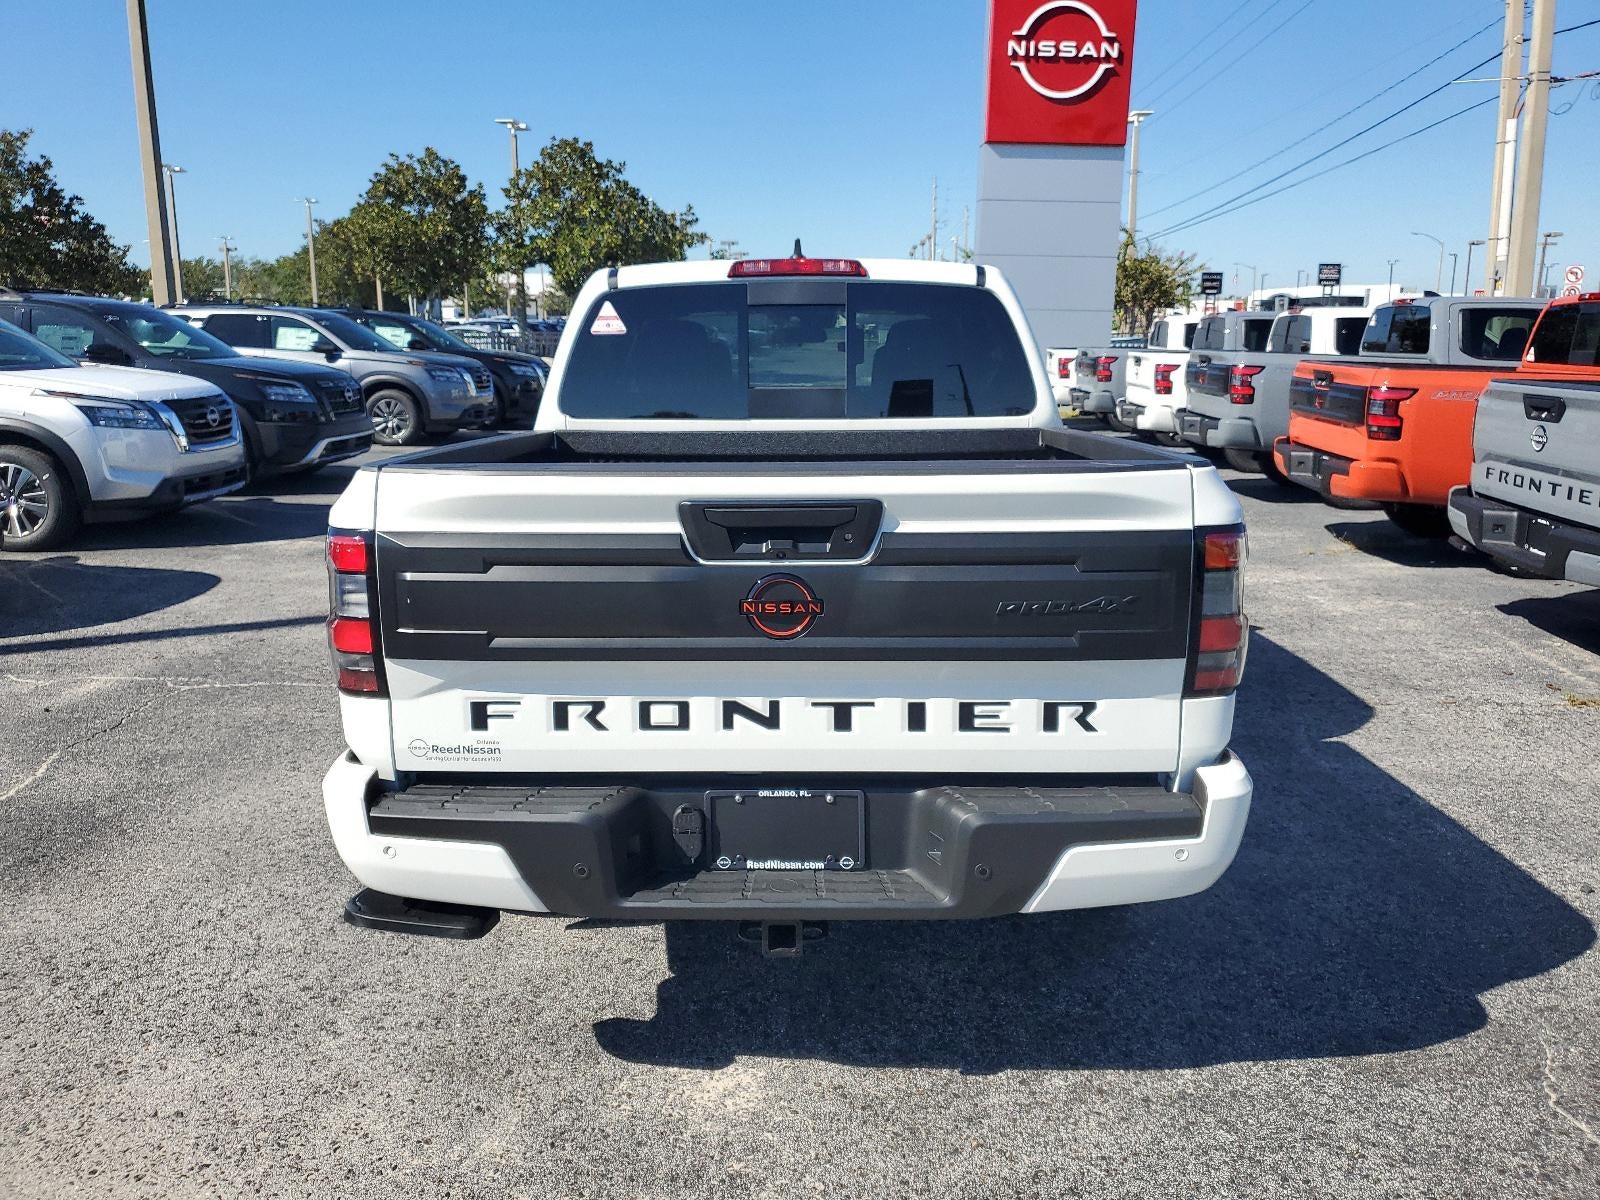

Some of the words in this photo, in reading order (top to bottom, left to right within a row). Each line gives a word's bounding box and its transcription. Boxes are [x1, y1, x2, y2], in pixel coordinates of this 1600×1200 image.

[1007, 39, 1120, 59] NISSAN
[743, 602, 821, 613] NISSAN
[469, 698, 1098, 732] FRONTIER
[431, 744, 460, 754] Reed
[462, 744, 501, 755] Nissan
[758, 790, 798, 798] ORLANDO,
[746, 860, 825, 870] ReedNissan.com
